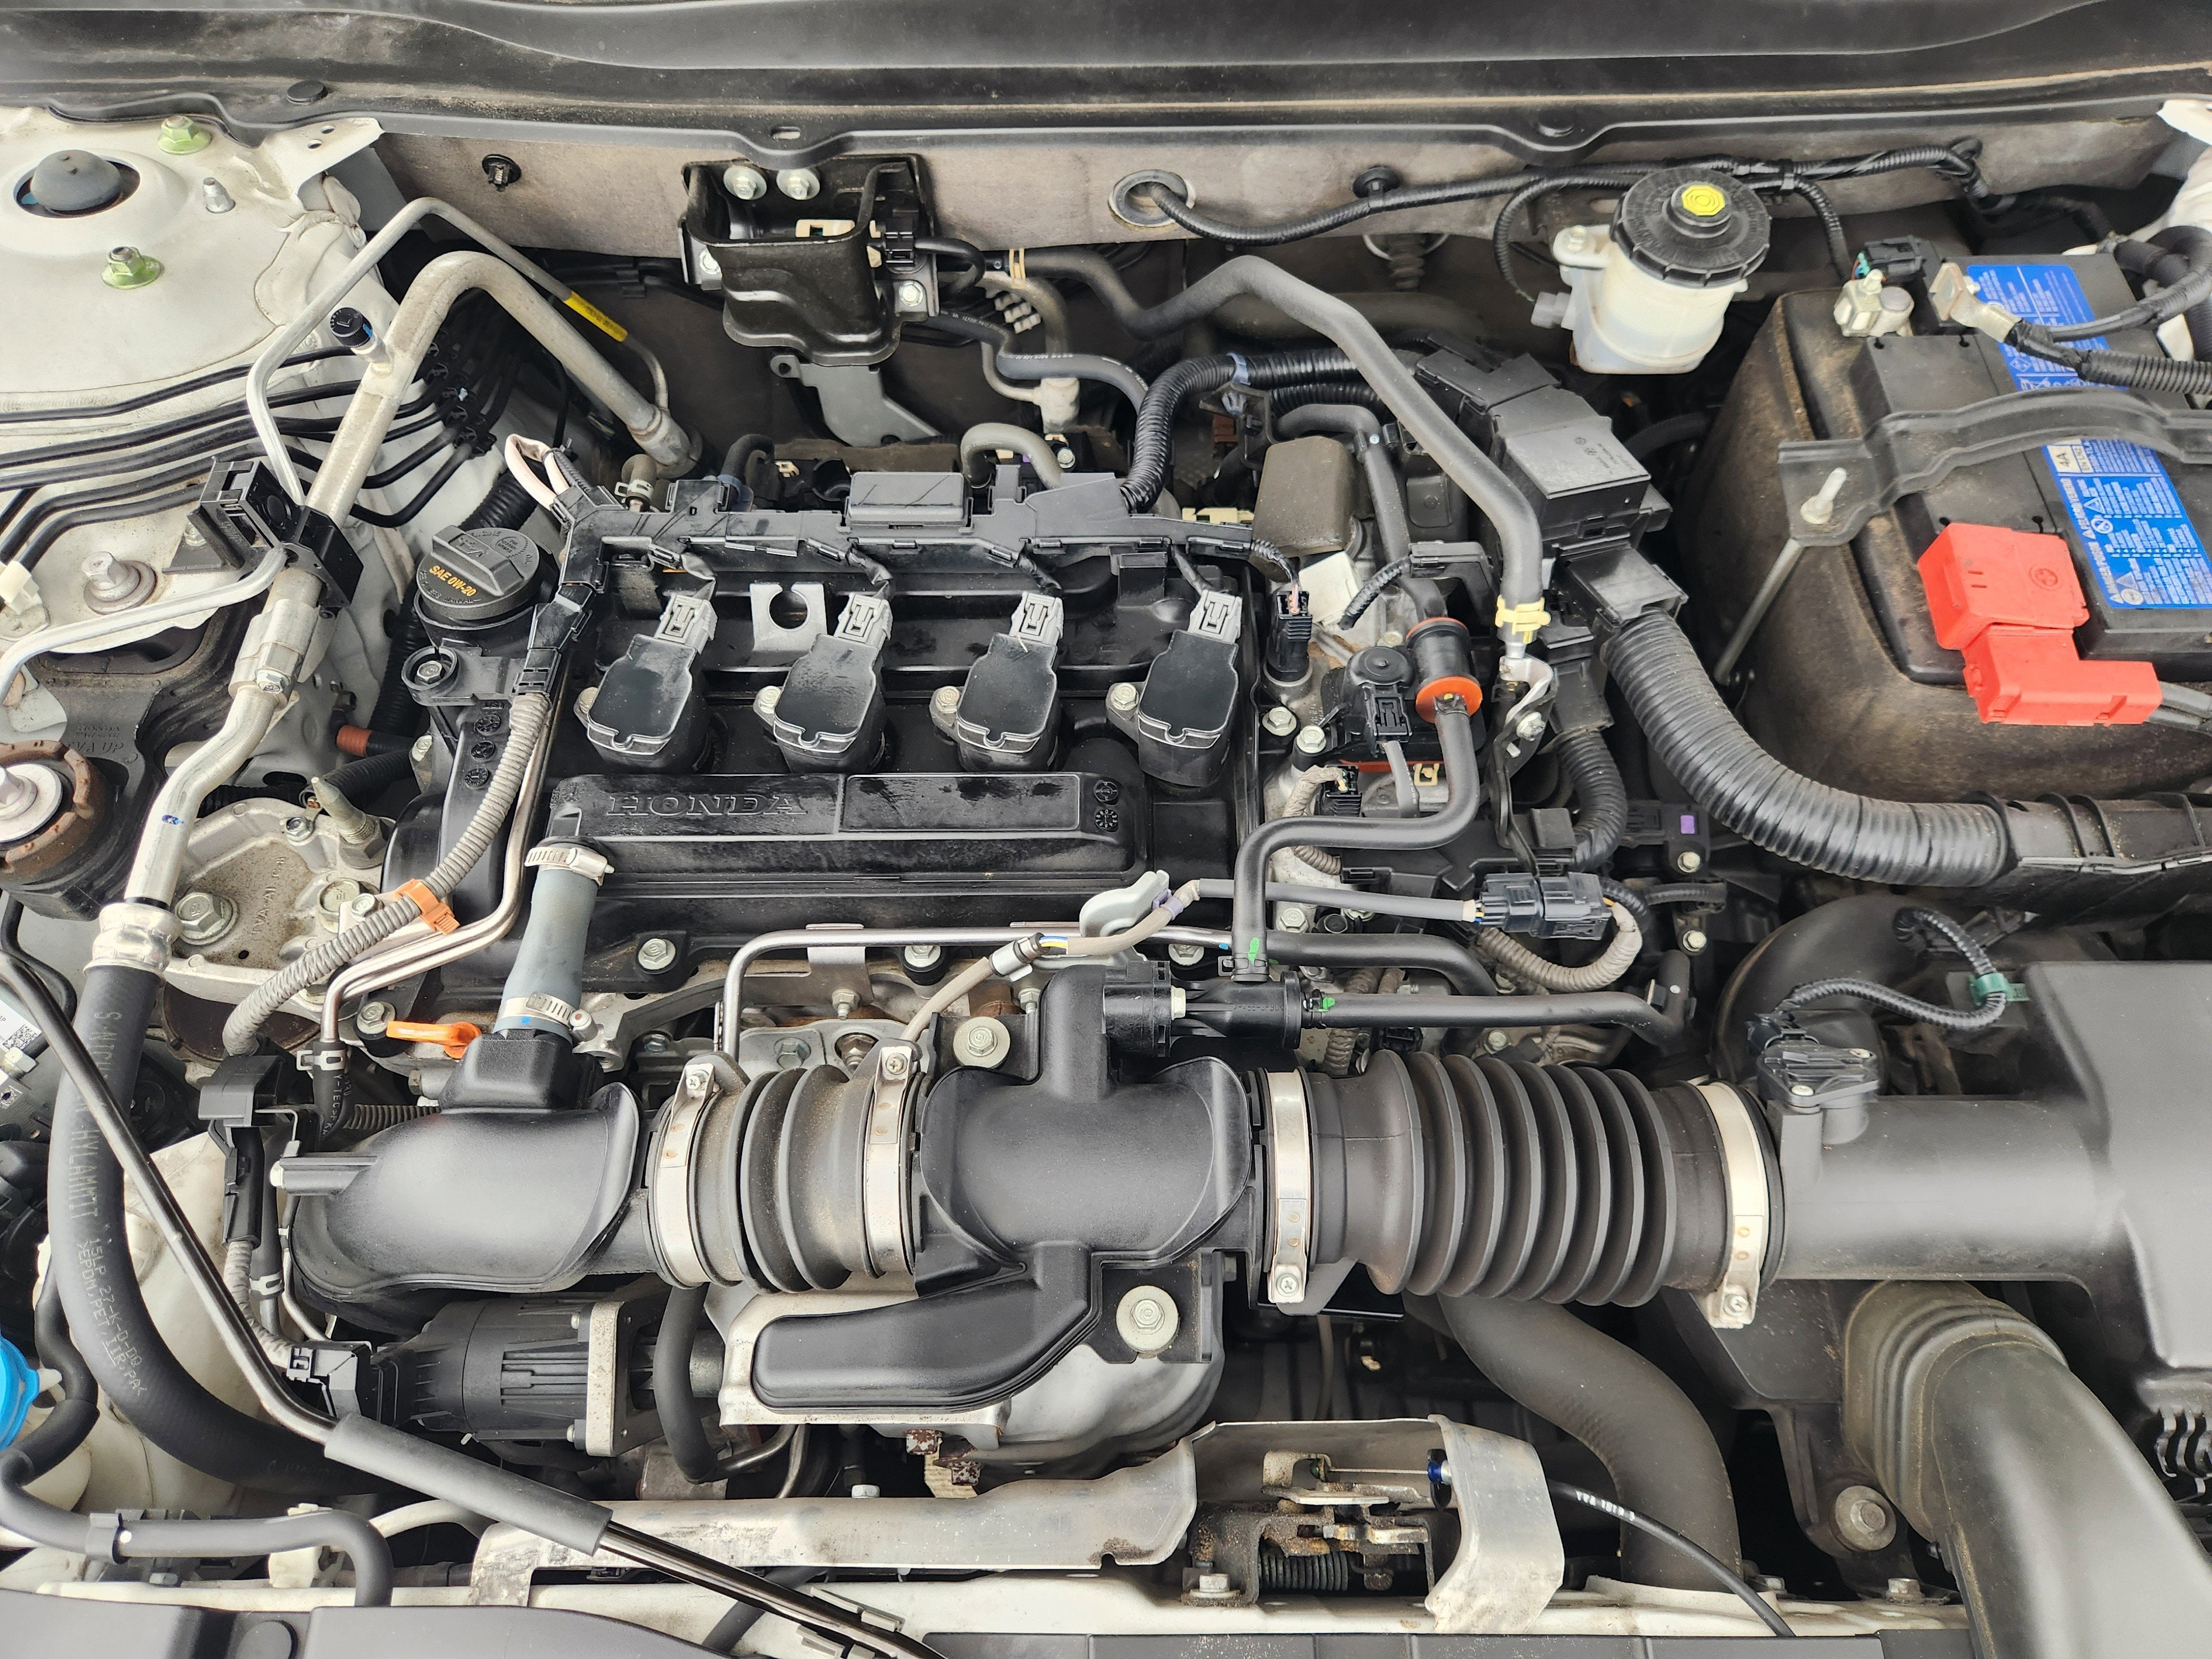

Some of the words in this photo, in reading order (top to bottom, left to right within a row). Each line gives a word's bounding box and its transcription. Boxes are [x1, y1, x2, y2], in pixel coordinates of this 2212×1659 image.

[429, 565, 452, 581] SAE
[447, 576, 477, 597] 0W-20
[606, 793, 808, 817] HONDA
